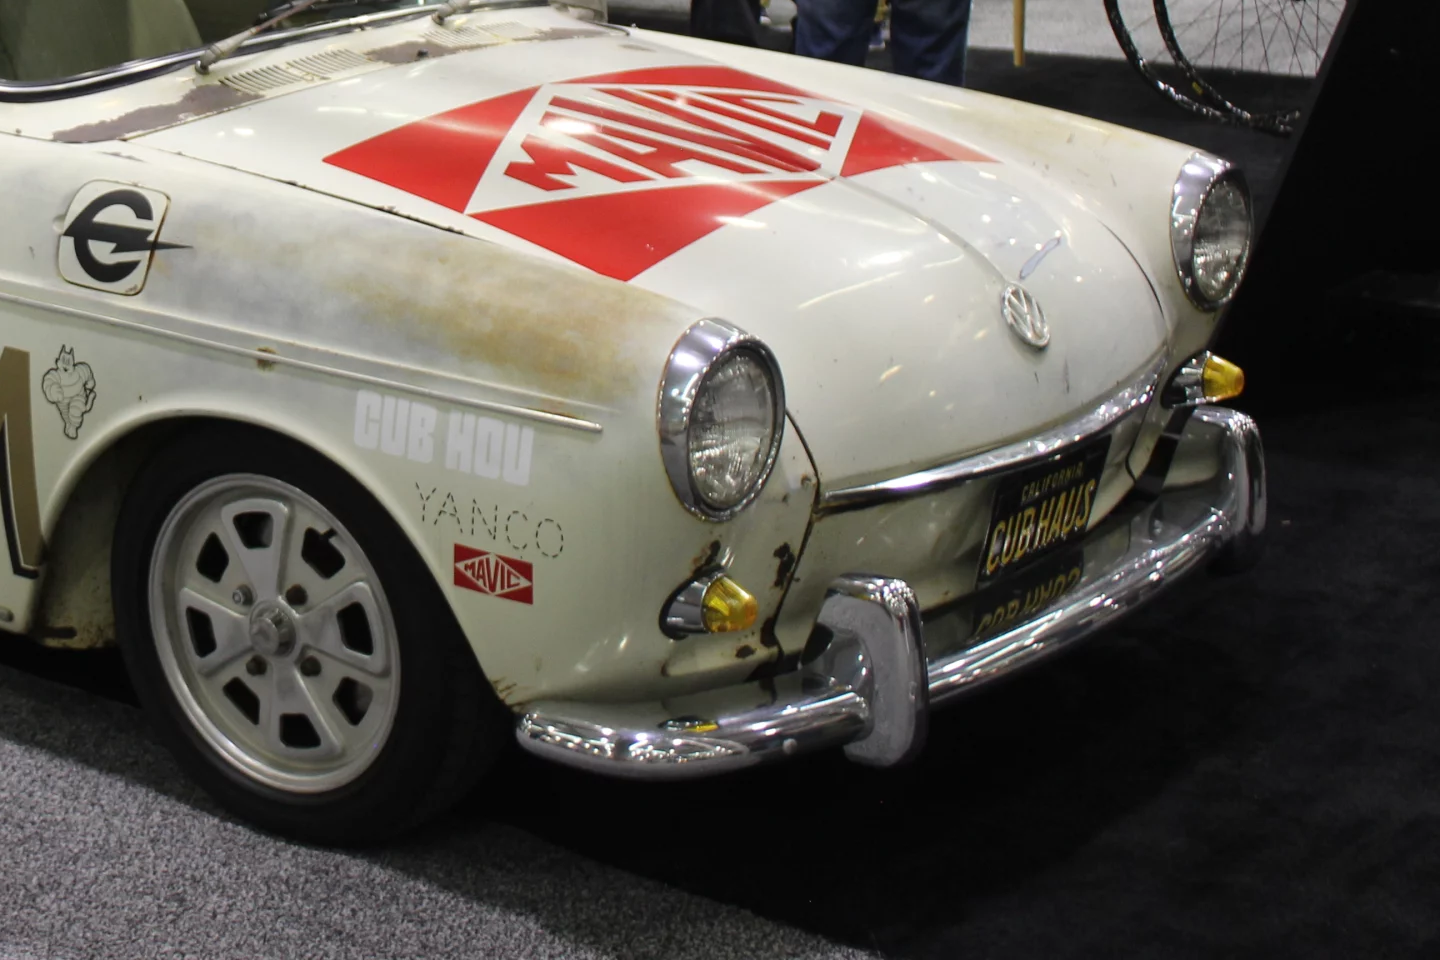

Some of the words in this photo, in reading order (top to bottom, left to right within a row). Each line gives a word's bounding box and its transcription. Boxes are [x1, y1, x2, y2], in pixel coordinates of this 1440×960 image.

[504, 86, 847, 192] MAVIC
[353, 389, 438, 464] CUB
[444, 408, 535, 487] HOU
[1021, 460, 1085, 503] CALIFORNIA
[414, 481, 564, 560] YANCO
[986, 506, 1037, 576] CUB
[1032, 478, 1097, 552] HAUS
[463, 555, 522, 593] MAVIC
